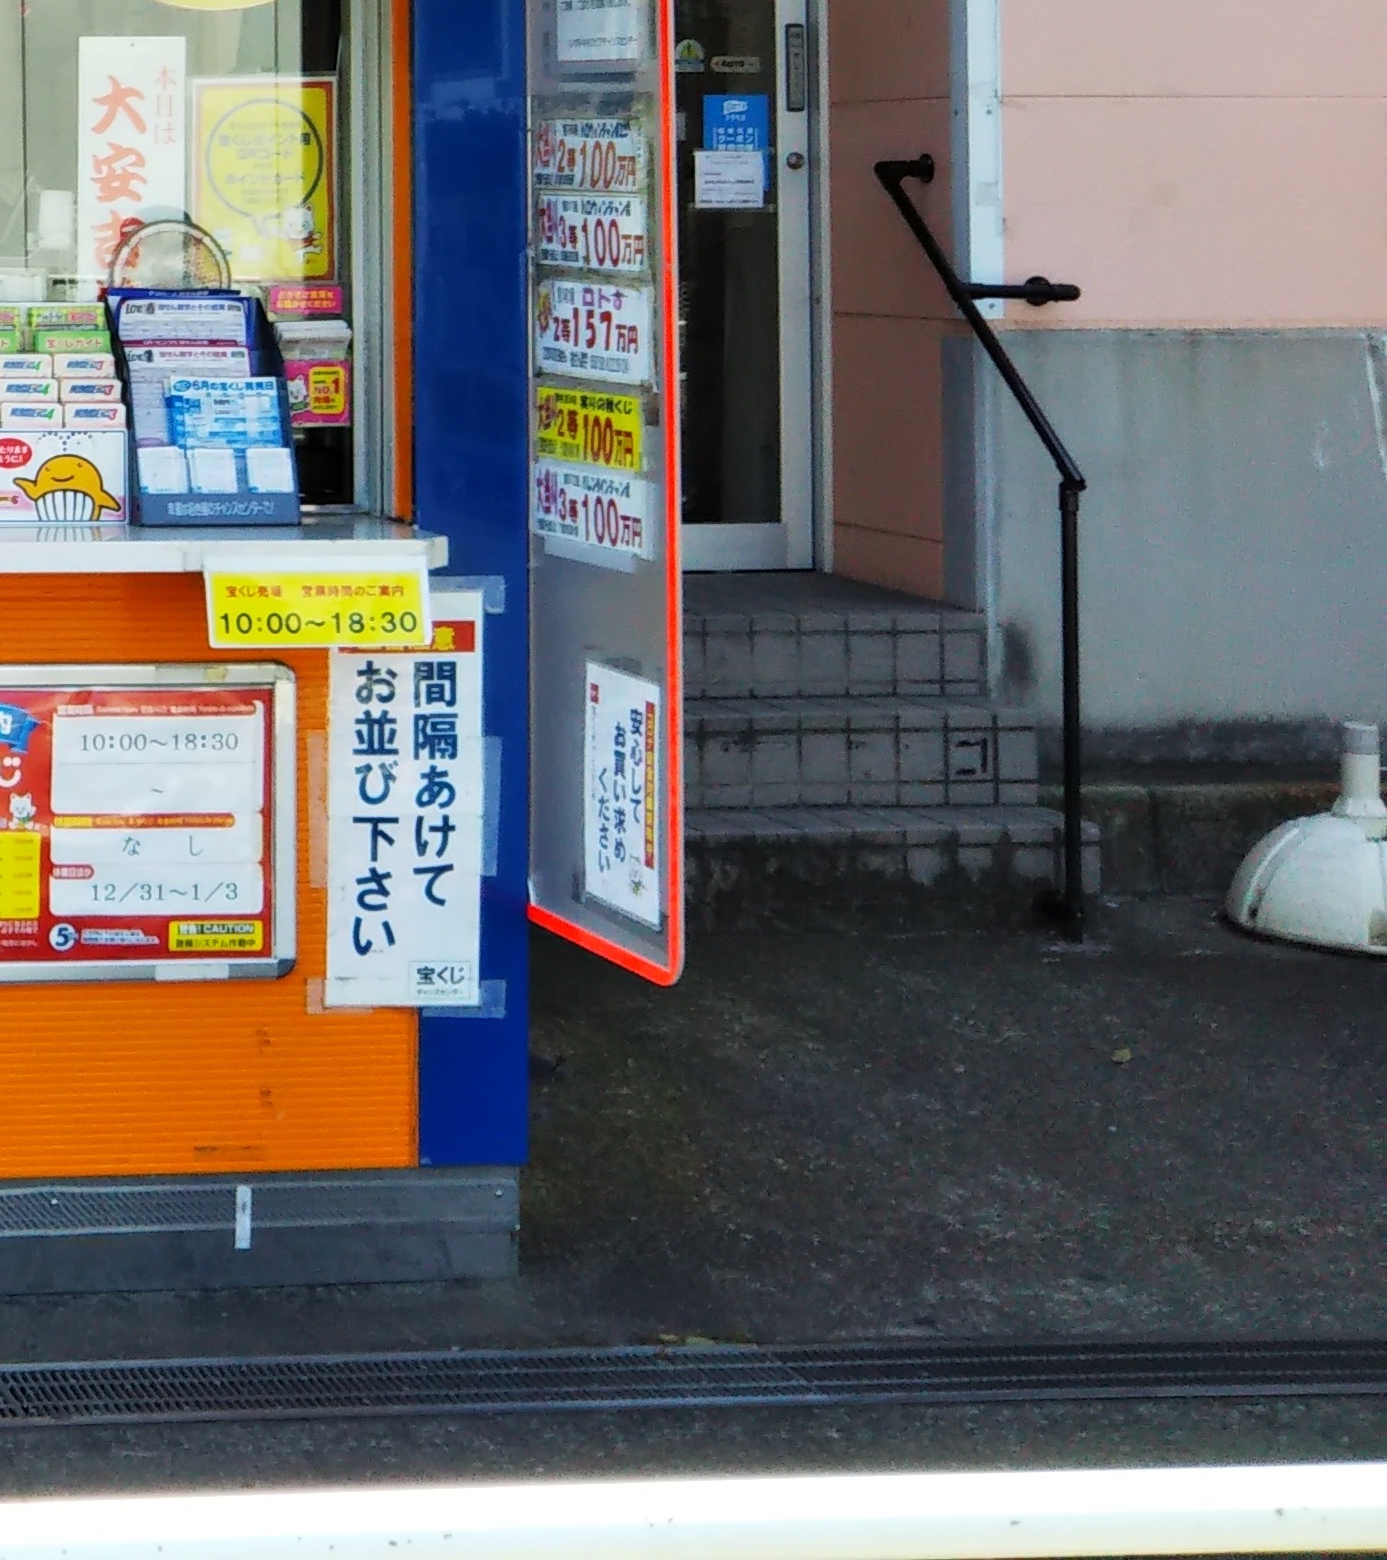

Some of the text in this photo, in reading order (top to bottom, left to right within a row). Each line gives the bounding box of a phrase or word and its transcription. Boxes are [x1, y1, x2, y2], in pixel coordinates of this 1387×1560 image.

[152, 64, 178, 146] 本日は
[300, 584, 406, 598] 営業時間のご案内
[219, 609, 419, 637] 10:00～18:30
[81, 733, 240, 752] 10:00～18:30
[412, 659, 459, 908] 間隔あけて
[352, 658, 401, 957] お並び下さい
[204, 924, 254, 934] CAUTION
[415, 965, 466, 986] 宝くじ
